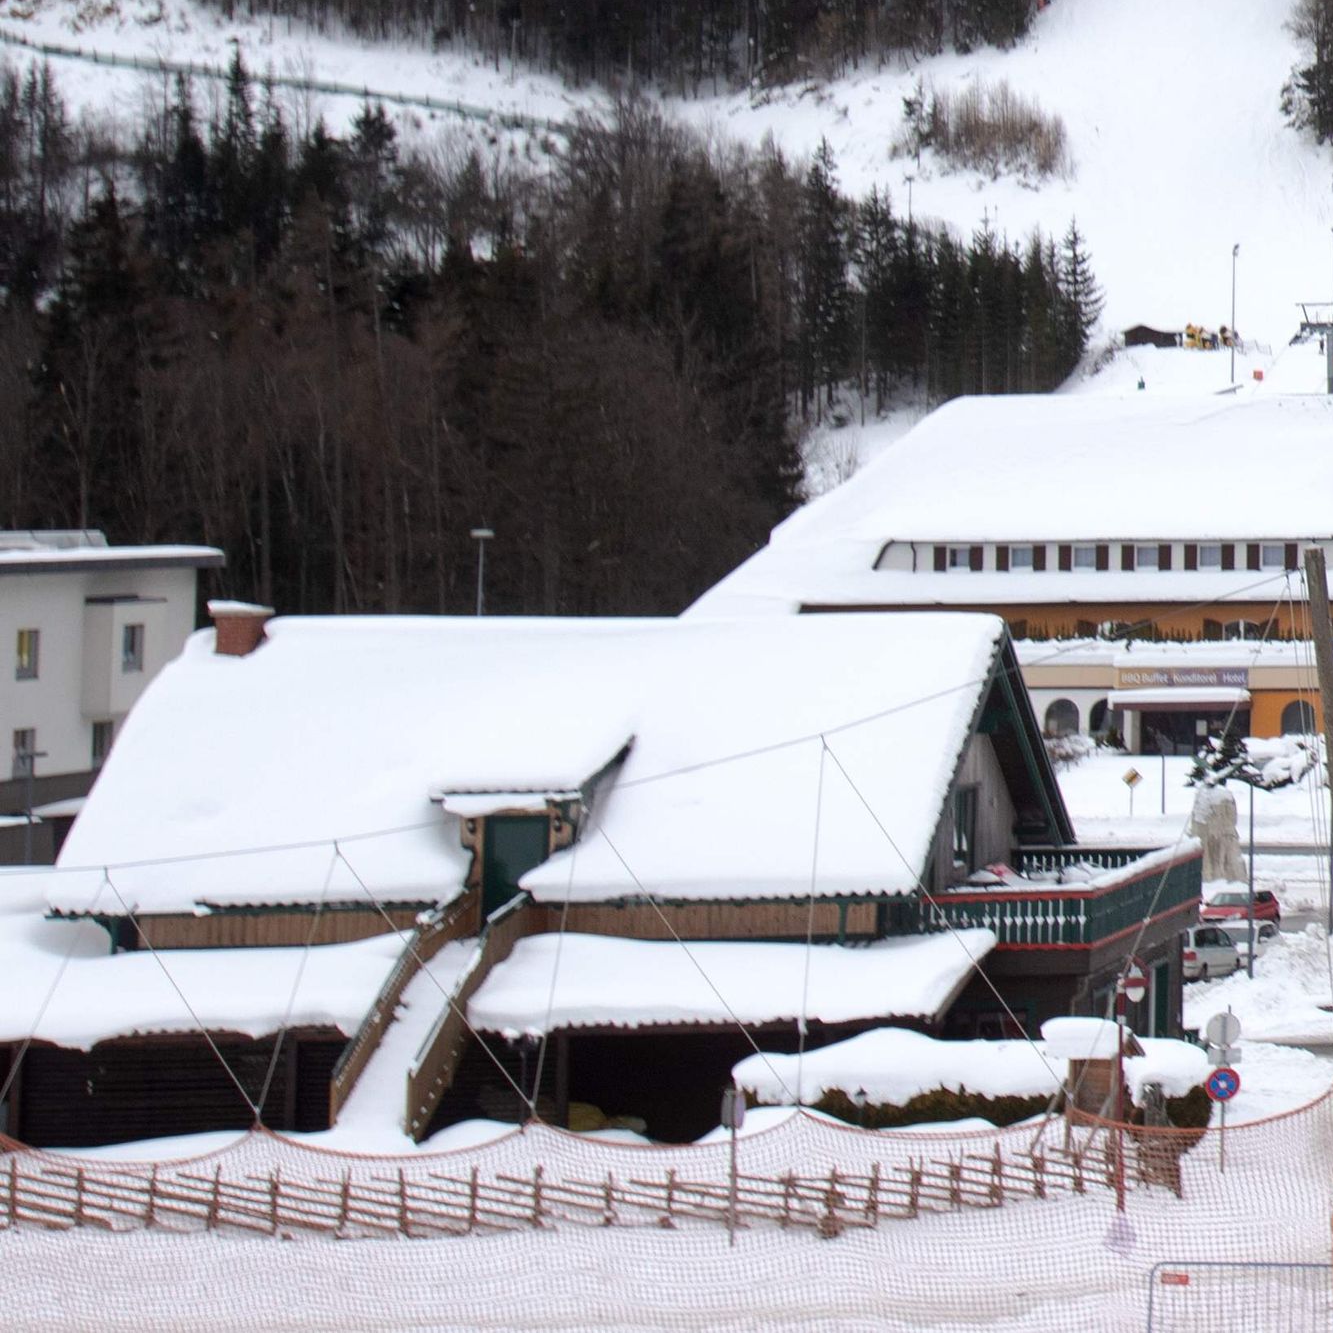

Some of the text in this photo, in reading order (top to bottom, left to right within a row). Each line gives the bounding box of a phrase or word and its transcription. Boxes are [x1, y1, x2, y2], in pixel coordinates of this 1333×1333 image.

[1121, 672, 1141, 684] BBQ
[1142, 672, 1168, 684] Buffet
[1222, 672, 1247, 684] Hotel
